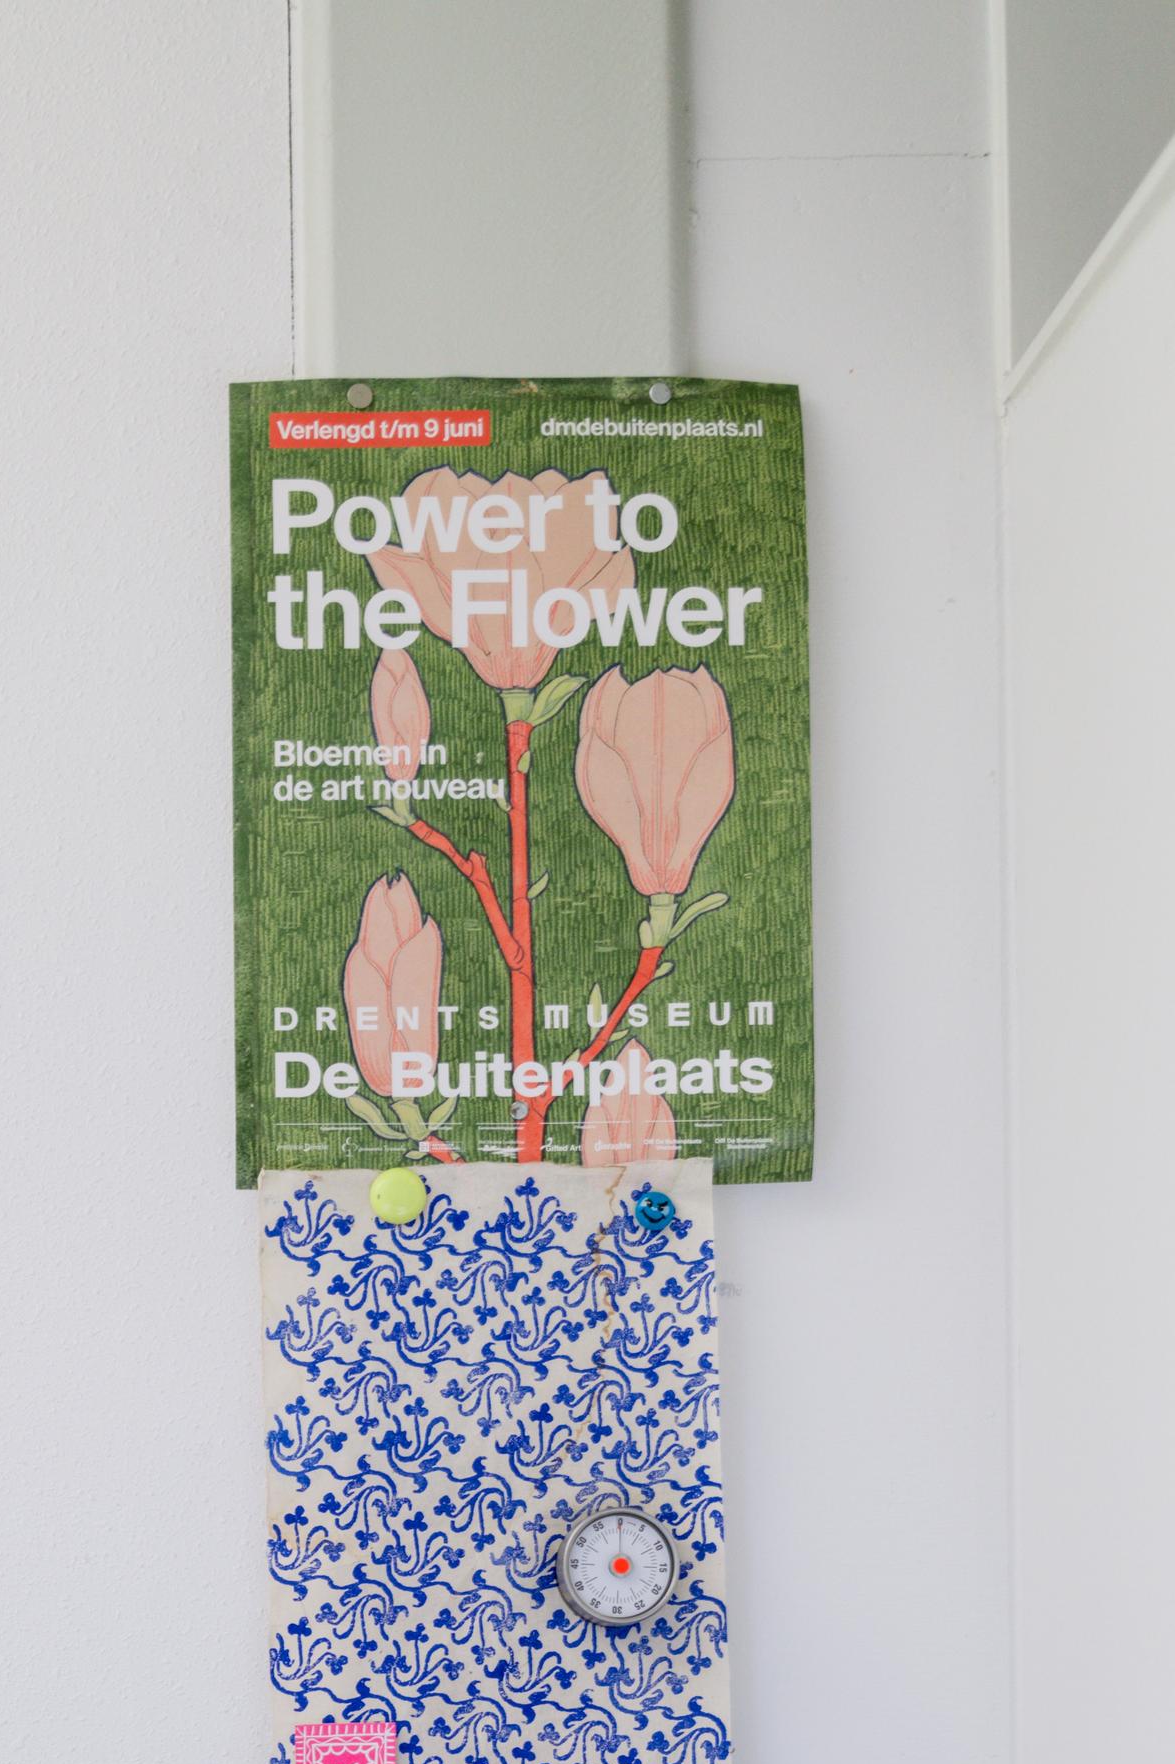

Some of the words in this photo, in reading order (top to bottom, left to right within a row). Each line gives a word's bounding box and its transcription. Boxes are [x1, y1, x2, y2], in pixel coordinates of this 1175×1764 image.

[277, 420, 374, 443] Verlengd
[380, 420, 419, 438] t/m
[424, 418, 439, 437] 9
[443, 418, 483, 441] juni
[540, 418, 763, 439] dmdebuitenplaats.nl
[271, 478, 563, 555] Power
[585, 478, 679, 553] to
[267, 569, 422, 650] the
[451, 568, 762, 648] Flower
[273, 740, 411, 767] Bloemen
[419, 739, 446, 765] in
[273, 774, 315, 801] de
[320, 775, 365, 801] art
[373, 779, 506, 800] nouveau
[274, 1006, 499, 1031] DRENTS
[274, 1051, 359, 1099] De
[391, 1048, 774, 1107] Buitenplaats
[592, 1521, 604, 1532] 55
[617, 1518, 623, 1526] 0
[638, 1524, 646, 1532] 5
[576, 1536, 587, 1548] 50
[653, 1540, 663, 1551] 10
[570, 1558, 579, 1569] 45
[659, 1563, 667, 1573] 15
[574, 1581, 584, 1592] 40
[651, 1583, 662, 1595] 20
[589, 1598, 601, 1609] 35
[634, 1599, 645, 1610] 25
[612, 1606, 622, 1614] 30
